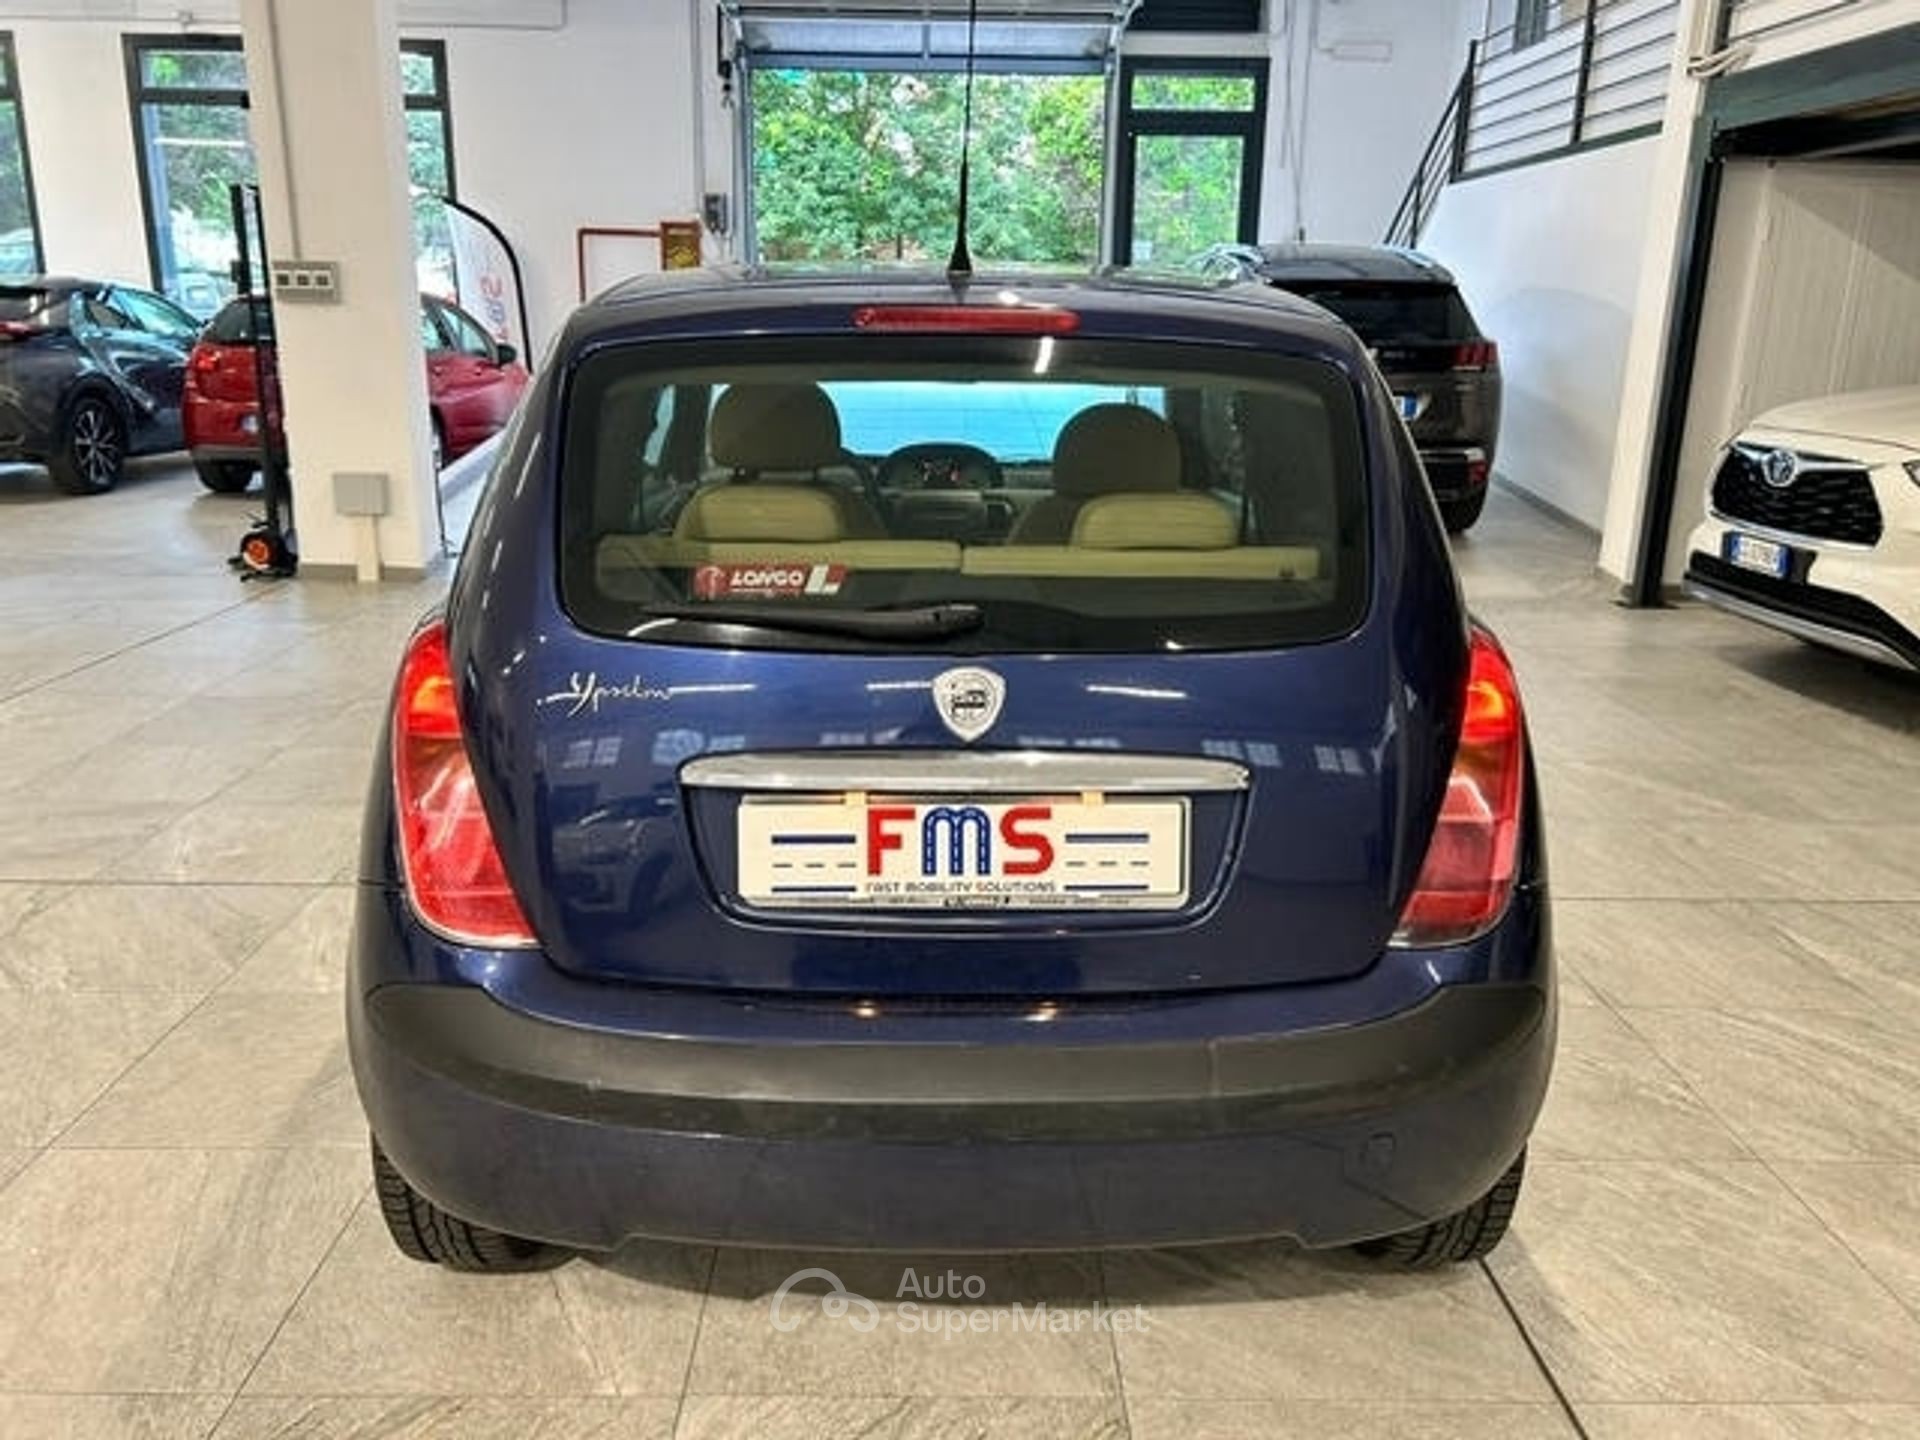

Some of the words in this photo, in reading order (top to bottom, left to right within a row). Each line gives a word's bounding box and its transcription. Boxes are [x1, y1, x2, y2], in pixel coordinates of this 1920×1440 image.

[866, 806, 1054, 876] FMS
[866, 881, 900, 893] FAST
[906, 881, 973, 893] MOBILITY
[976, 881, 1057, 893] SOLUTIONS
